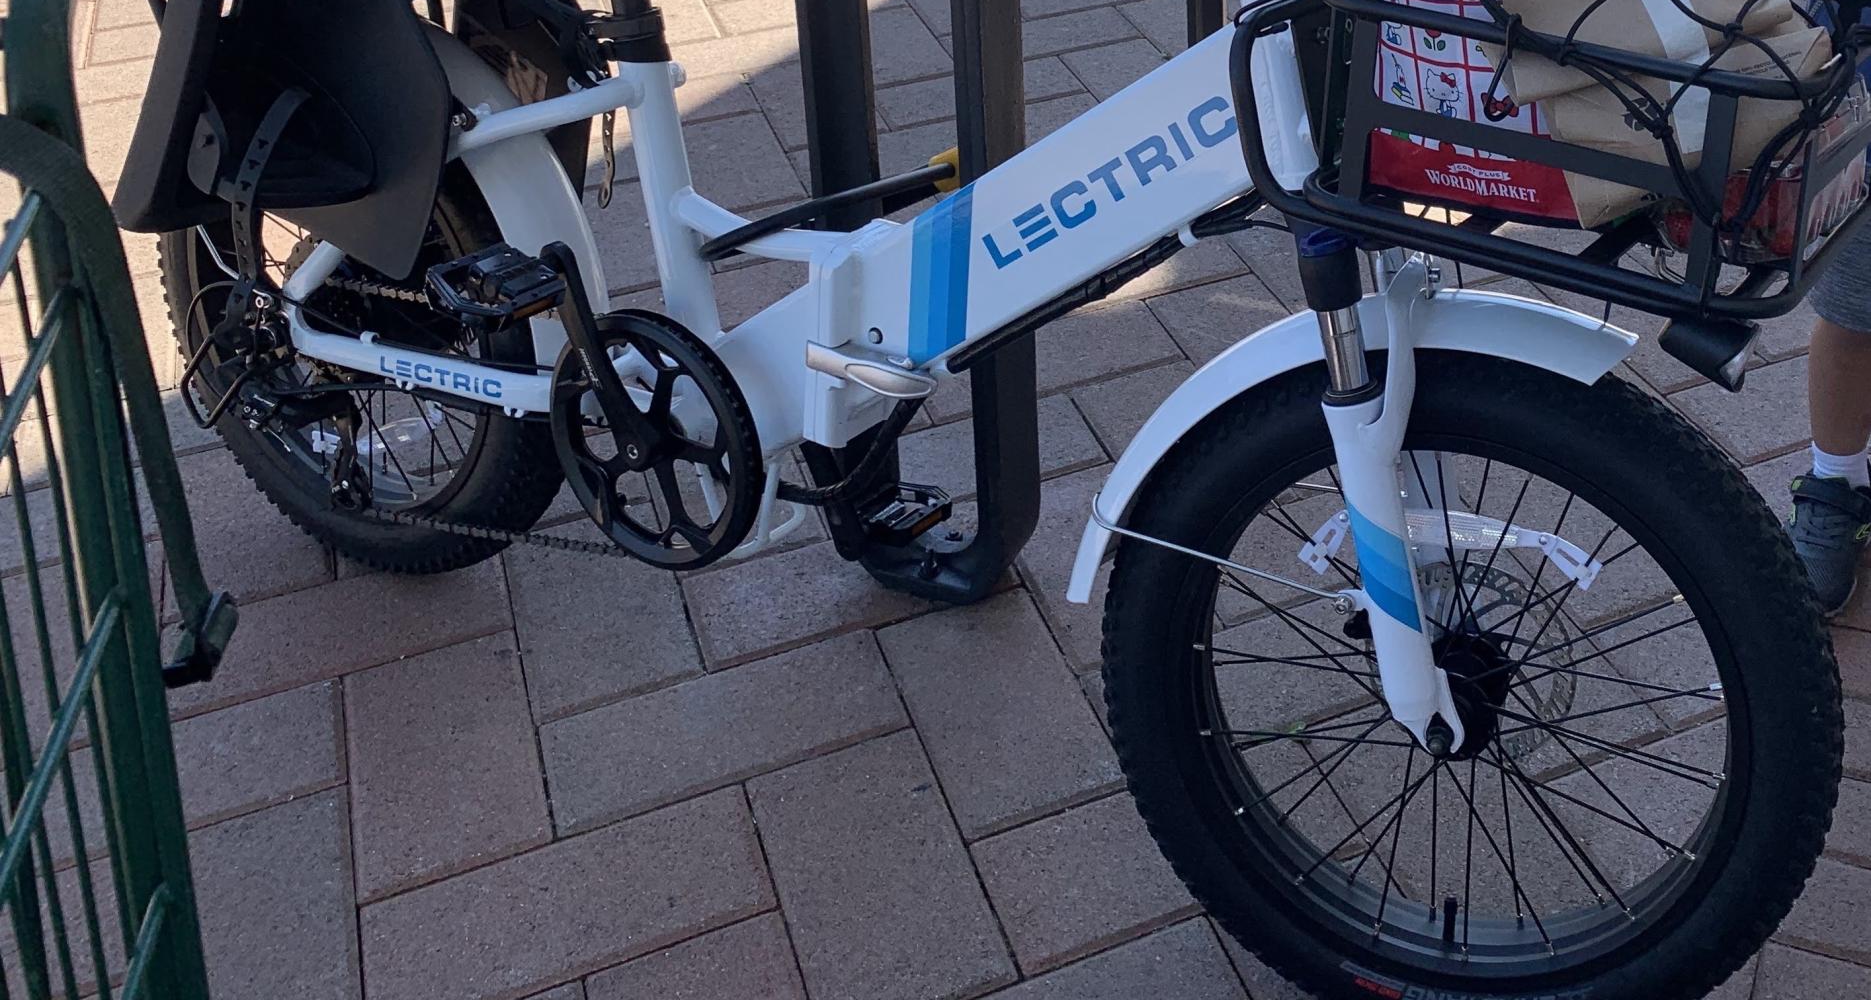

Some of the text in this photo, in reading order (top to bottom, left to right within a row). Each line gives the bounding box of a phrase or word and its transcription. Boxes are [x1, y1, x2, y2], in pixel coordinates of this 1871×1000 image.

[981, 95, 1239, 270] LECTRIC
[1456, 164, 1502, 178] COST PLUS
